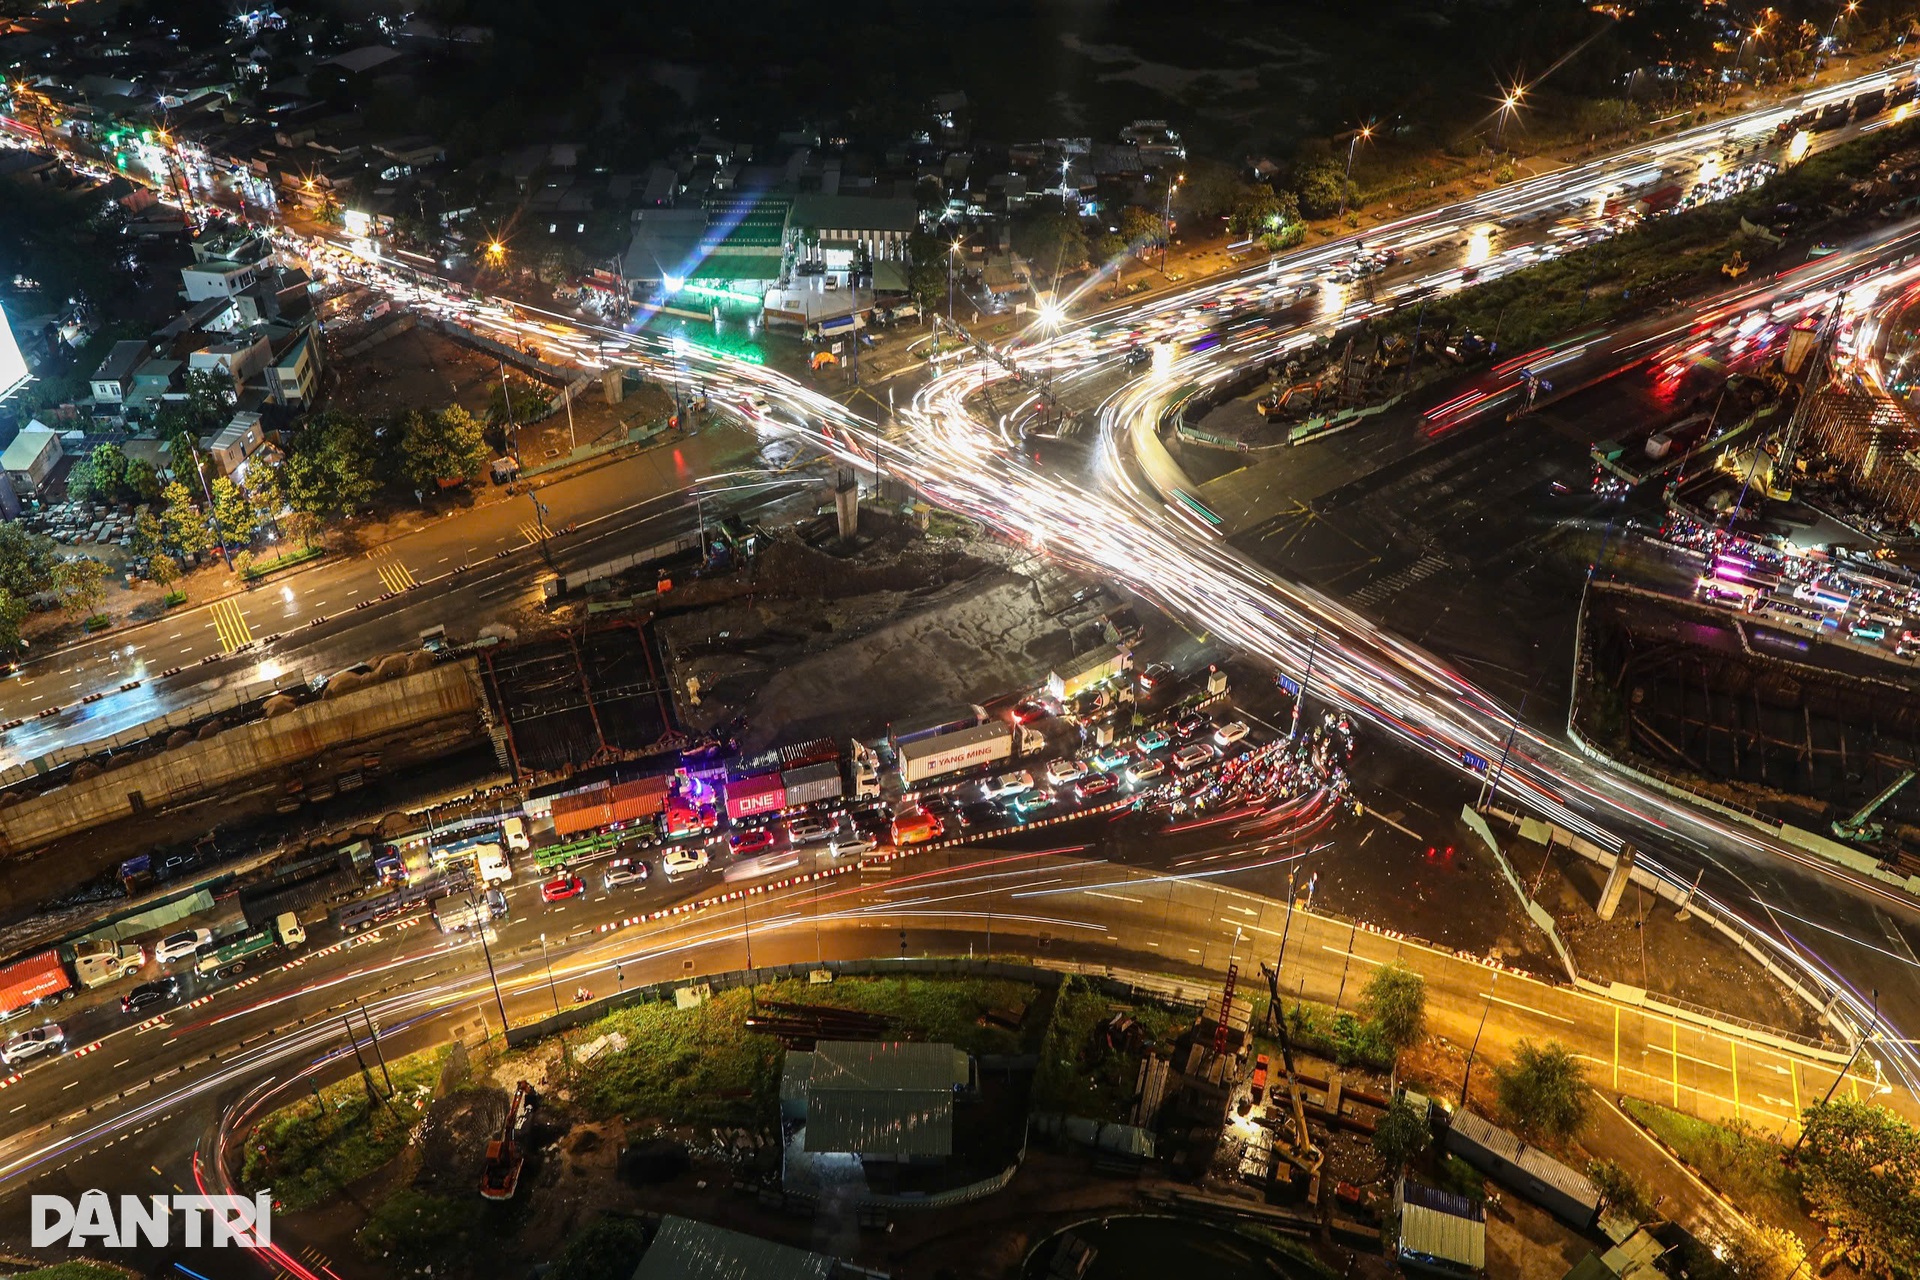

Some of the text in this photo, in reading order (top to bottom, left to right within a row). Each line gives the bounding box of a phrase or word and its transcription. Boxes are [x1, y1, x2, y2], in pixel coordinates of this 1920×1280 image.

[939, 747, 992, 766] YANG MING
[739, 794, 773, 810] ONE
